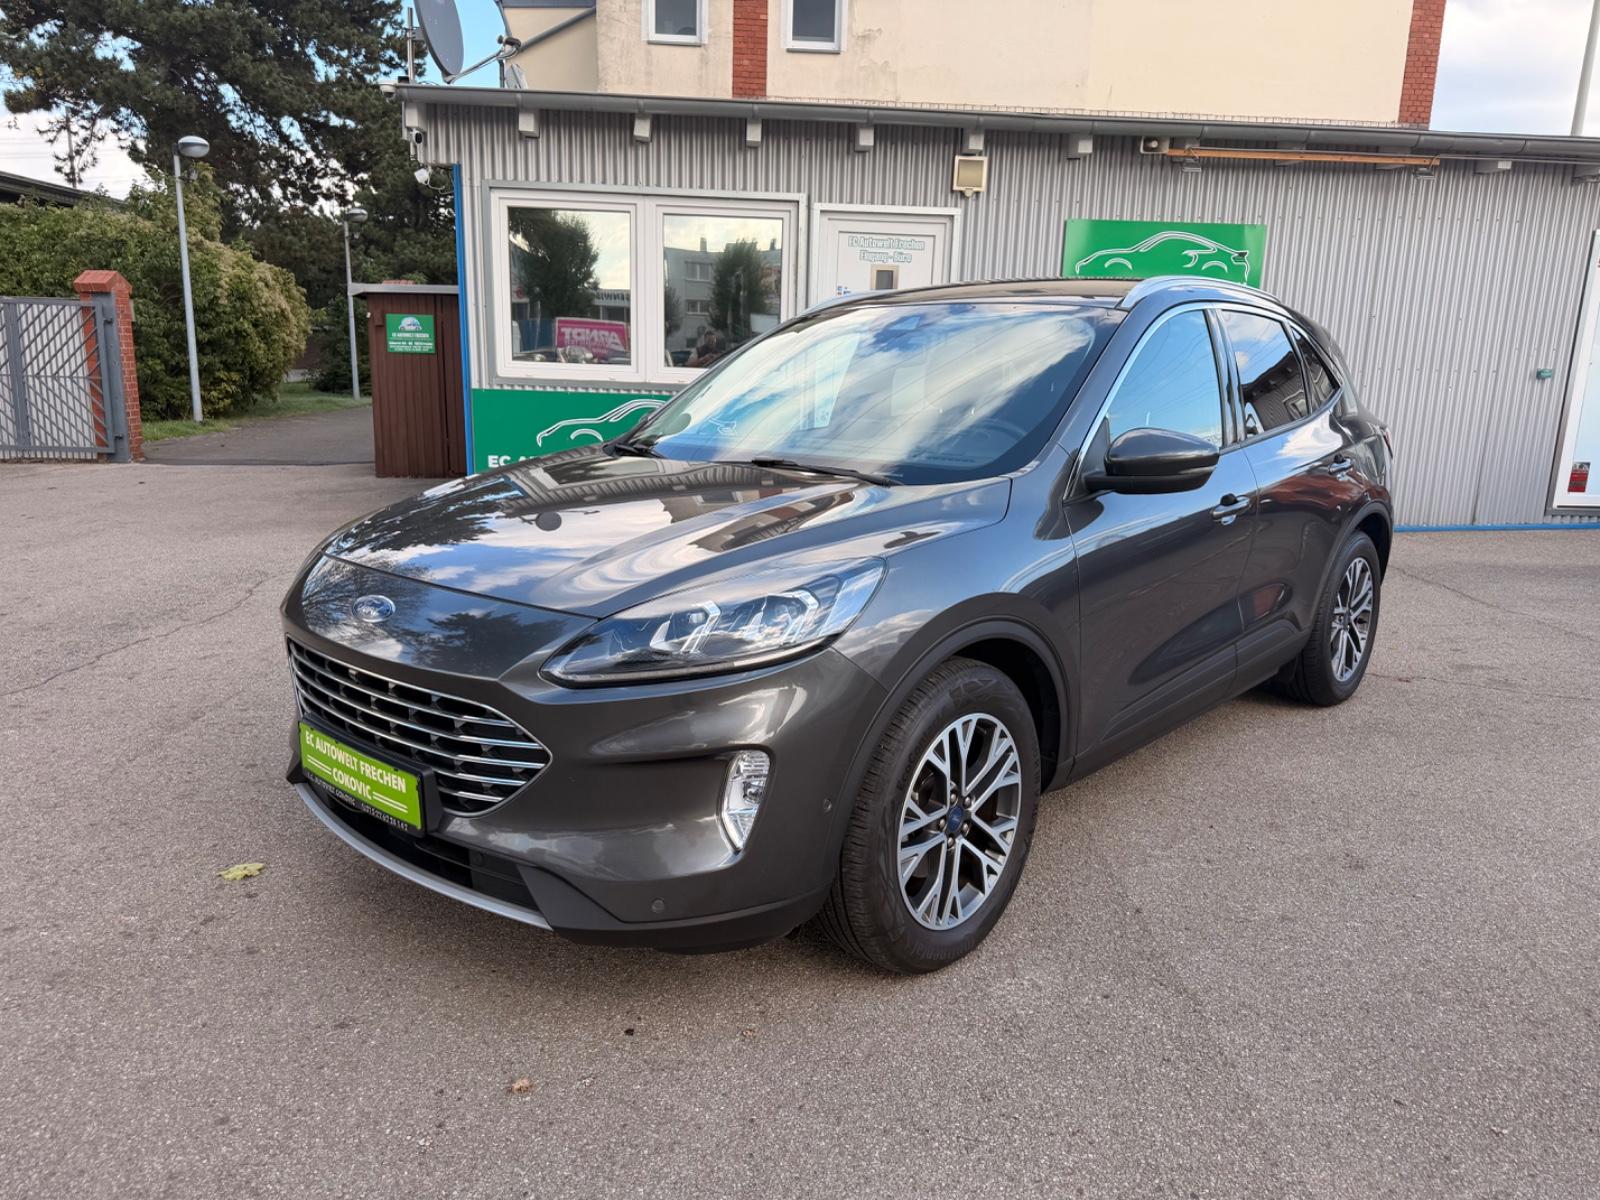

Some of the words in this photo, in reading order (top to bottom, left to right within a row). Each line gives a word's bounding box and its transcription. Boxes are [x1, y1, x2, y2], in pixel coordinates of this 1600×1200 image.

[487, 455, 513, 469] EC
[305, 731, 314, 746] EC
[315, 740, 358, 769] AUTOWELT
[360, 760, 406, 793] FRECHEN
[332, 768, 372, 800] COKOVIC
